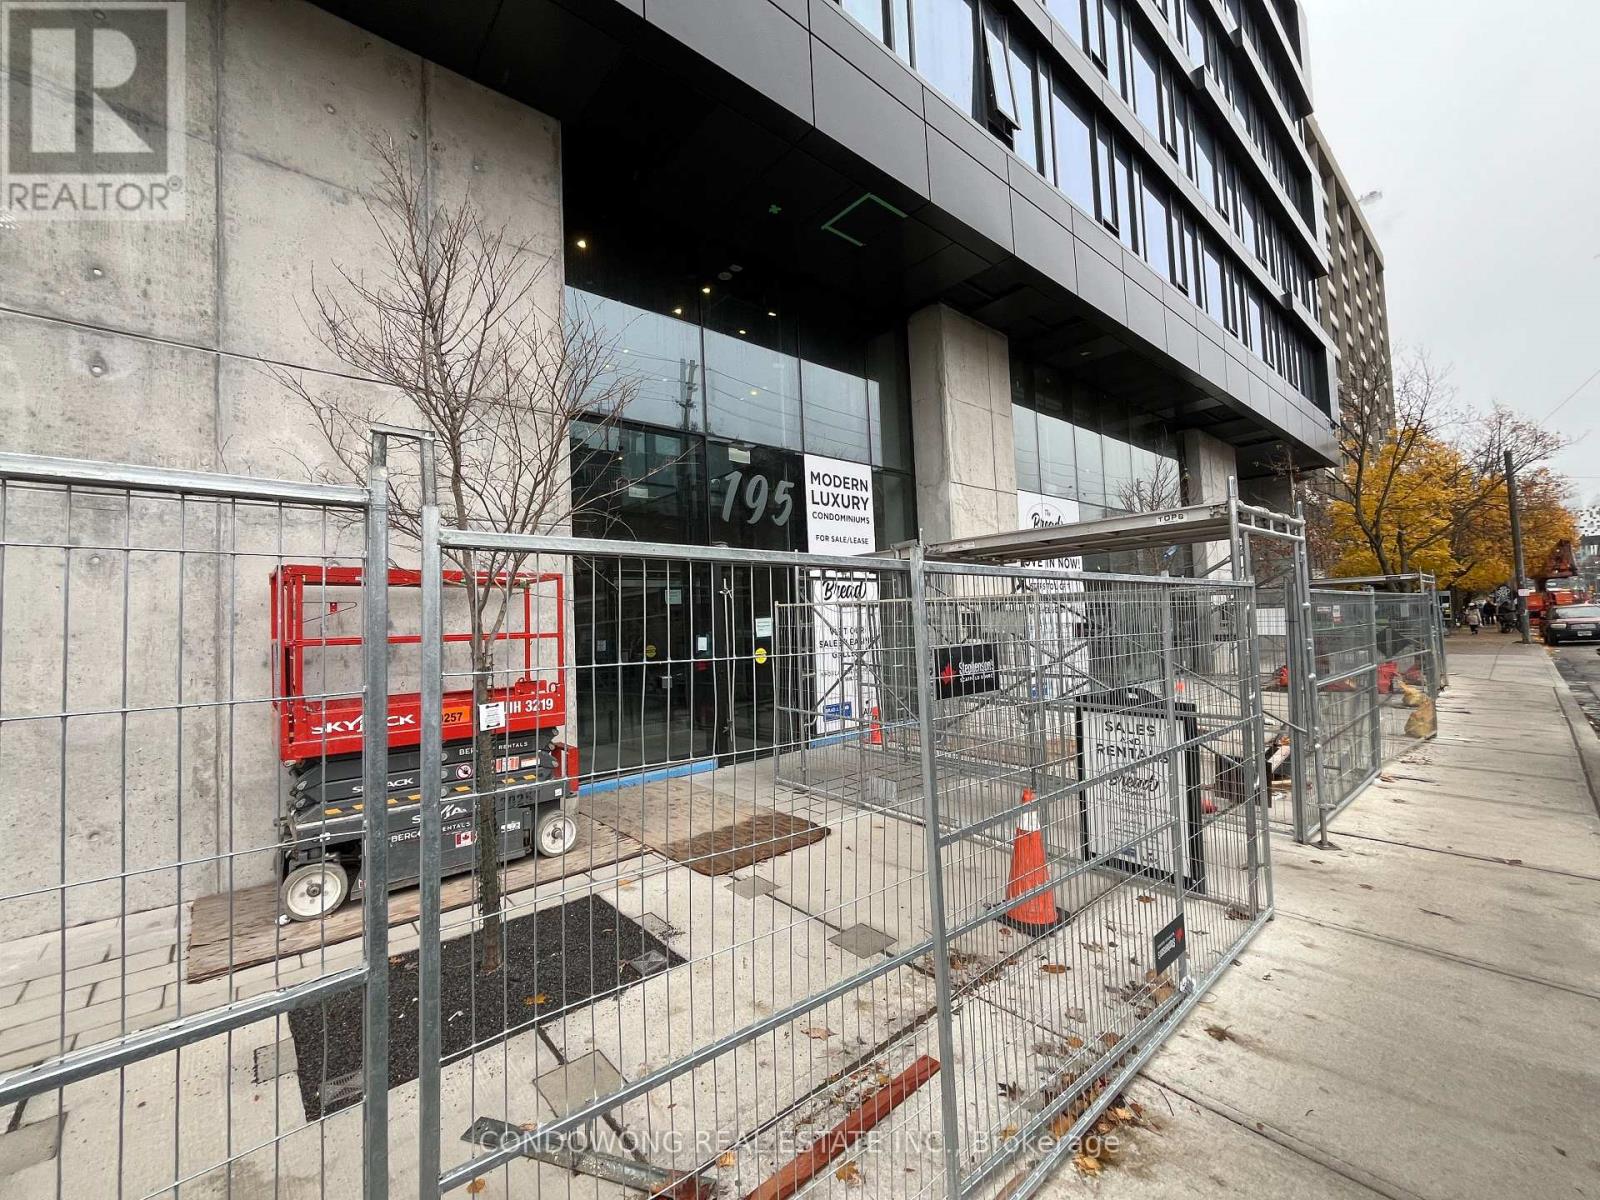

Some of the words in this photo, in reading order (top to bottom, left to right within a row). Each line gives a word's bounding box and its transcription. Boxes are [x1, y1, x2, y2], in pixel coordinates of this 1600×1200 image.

[810, 470, 869, 492] MODERN
[721, 471, 795, 526] 195
[811, 489, 869, 511] LUXURY
[812, 511, 870, 525] CONDOMINIUMS
[816, 534, 829, 542] FOR
[831, 535, 870, 545] SALE/LEASE
[1058, 557, 1081, 570] NOW!
[822, 580, 867, 601] Bread
[525, 698, 554, 713] 3219
[311, 713, 416, 735] SKYJCK
[442, 711, 463, 724] 257
[442, 821, 471, 832] ENTALS
